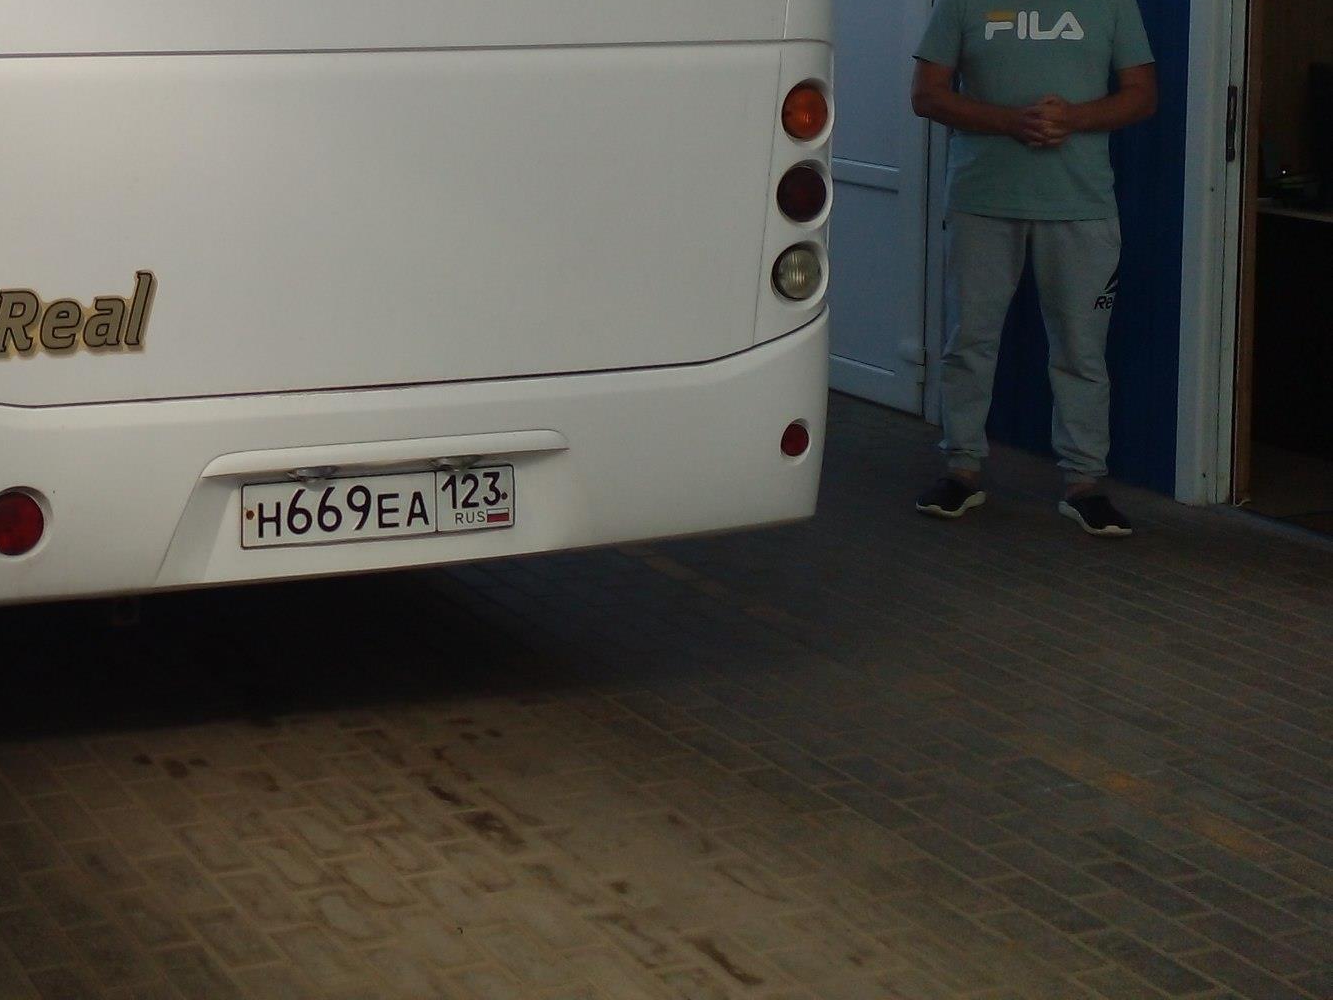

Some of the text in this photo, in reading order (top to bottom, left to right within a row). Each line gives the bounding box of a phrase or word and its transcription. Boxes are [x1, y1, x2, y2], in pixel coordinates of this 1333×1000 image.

[984, 11, 1085, 41] FILA
[441, 471, 501, 510] 123
[454, 511, 486, 525] RUS
